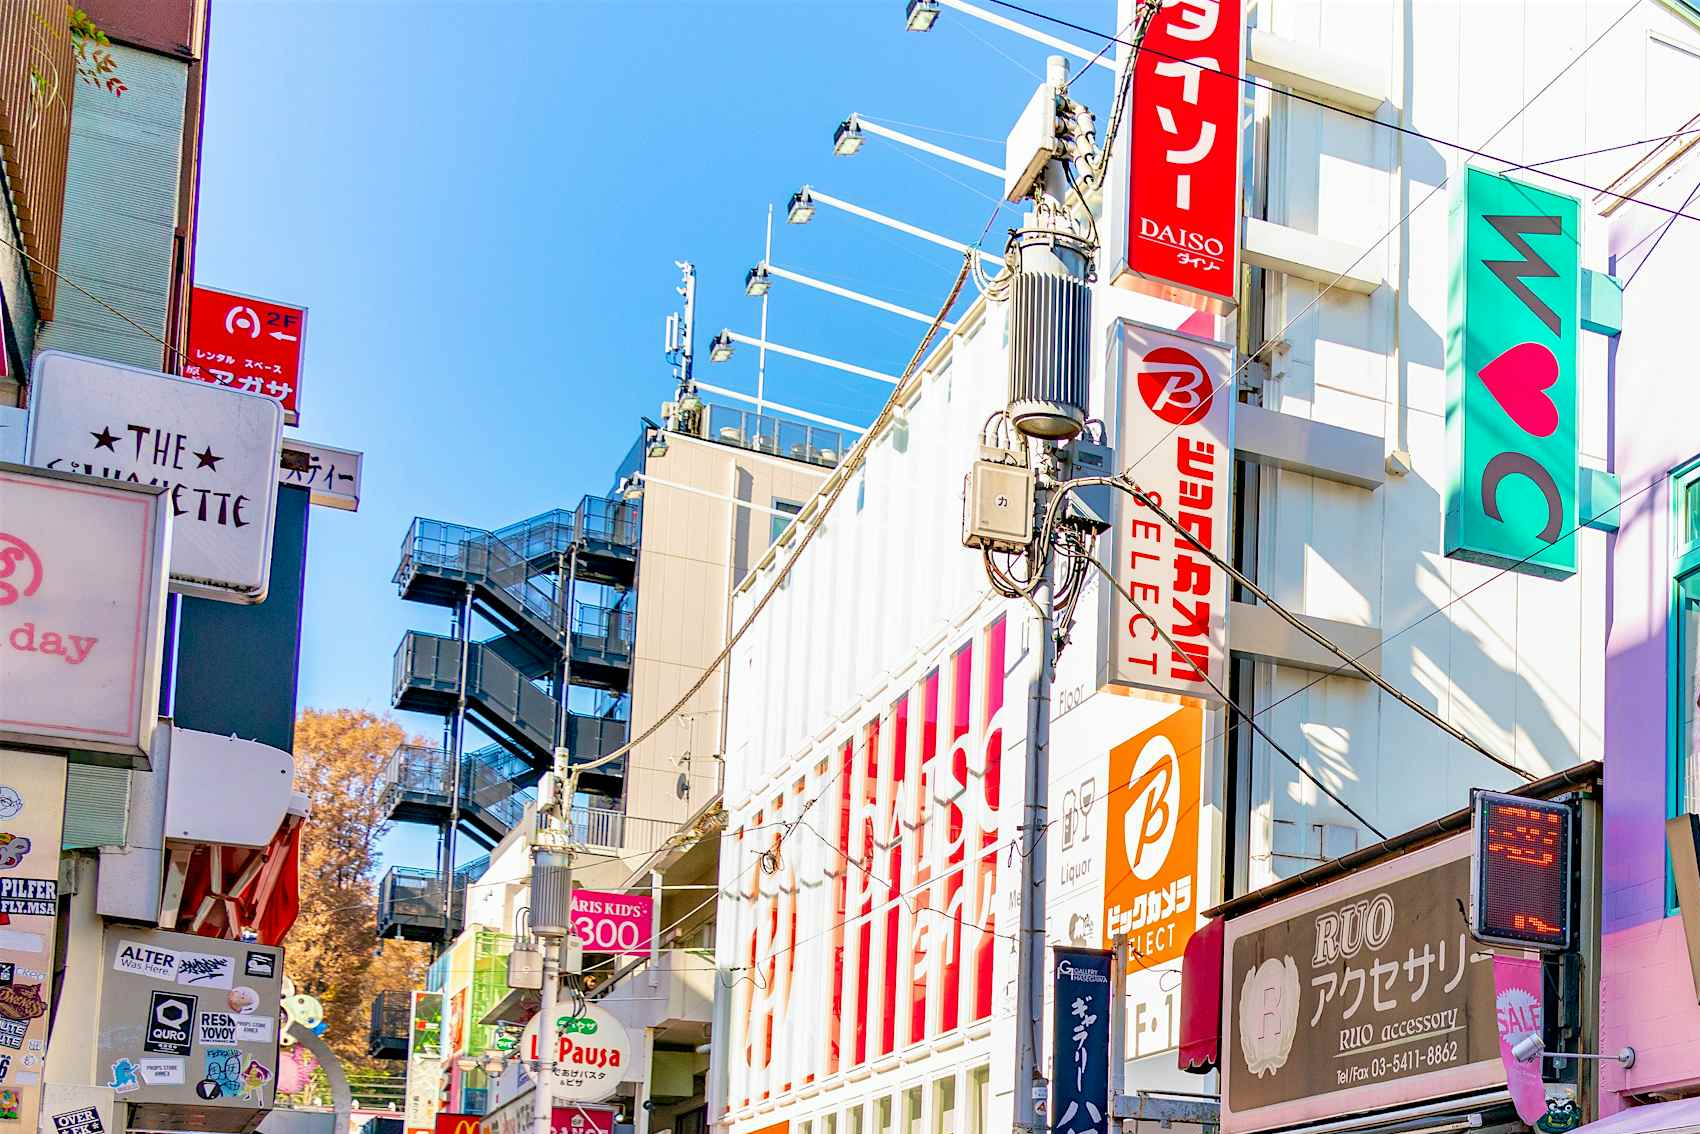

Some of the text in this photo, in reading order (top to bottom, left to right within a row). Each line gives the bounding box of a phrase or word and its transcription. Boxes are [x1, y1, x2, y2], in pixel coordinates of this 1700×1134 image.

[1139, 215, 1224, 257] DAISO
[1177, 250, 1221, 272] ダイソー
[1482, 215, 1562, 337] W
[267, 312, 298, 327] 2F
[196, 349, 282, 374] レンタル スペース
[209, 368, 293, 400] アガサ
[128, 424, 187, 470] THE
[1482, 451, 1563, 543] C
[1170, 435, 1215, 683] ビックカメラ
[1128, 487, 1161, 675] SELECT
[9, 623, 97, 664] day
[1060, 685, 1085, 714] Floor
[1061, 858, 1091, 885] Liquor
[1, 879, 56, 899] PILFER
[572, 896, 602, 913] ARIS
[1107, 874, 1193, 940] ビックカメラ
[1126, 919, 1176, 963] ELECT
[1313, 893, 1395, 970] RUO
[121, 946, 175, 968] ALTER
[121, 958, 142, 970] Was
[1310, 931, 1494, 1027] アクセサリー
[153, 1028, 186, 1041] QURO
[202, 1027, 236, 1039] YOVOY
[1339, 1006, 1458, 1050] RUO accessory
[1496, 1002, 1540, 1035] SALE
[559, 1036, 621, 1068] Pausa
[1071, 995, 1098, 1092] ギャラリー
[1336, 1042, 1458, 1086] Tel/Fax 03-5411-8862
[59, 1110, 94, 1127] OVER
